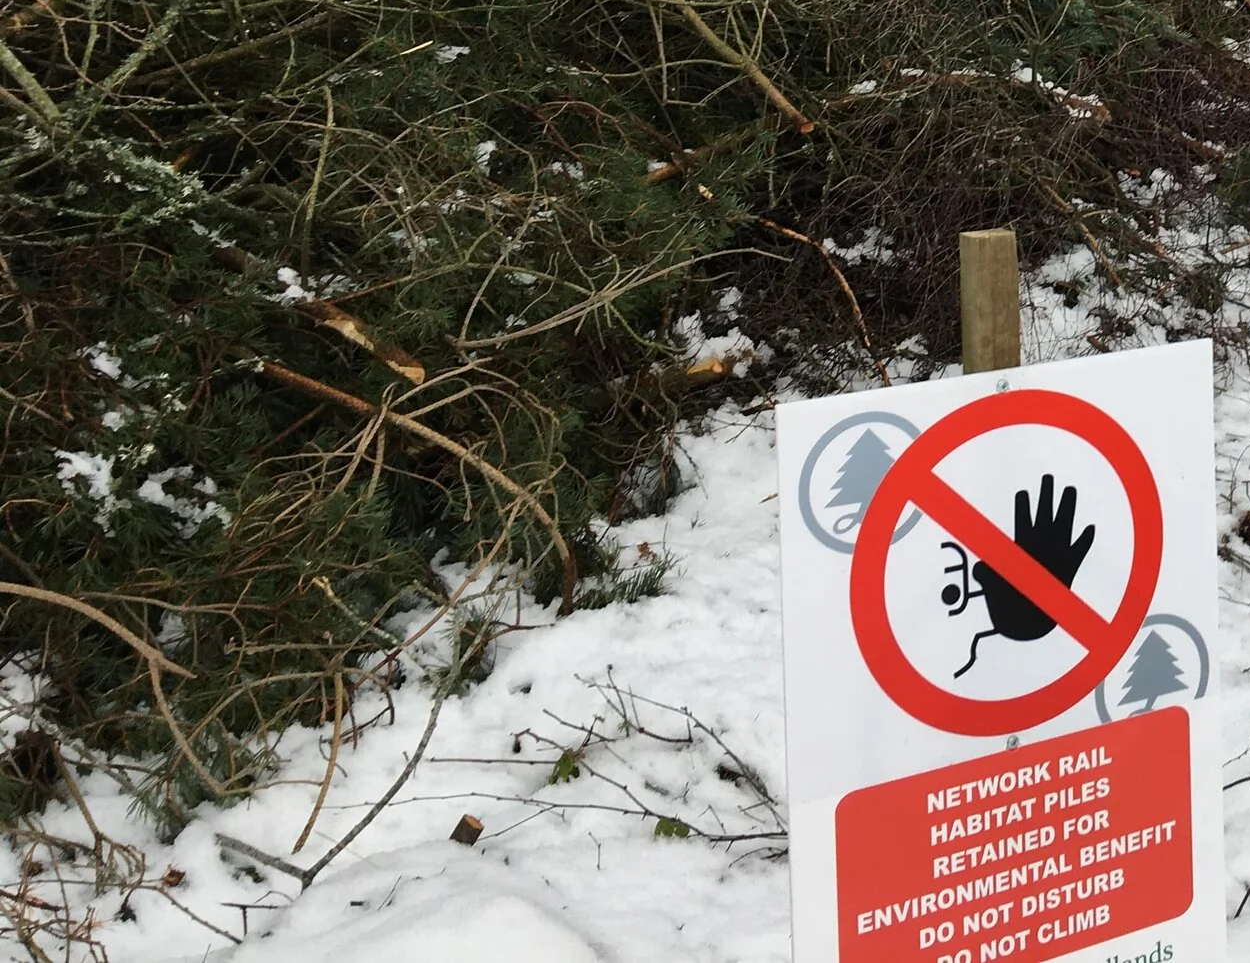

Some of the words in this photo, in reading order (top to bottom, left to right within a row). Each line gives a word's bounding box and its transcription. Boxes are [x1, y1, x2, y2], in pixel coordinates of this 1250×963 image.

[928, 761, 1051, 814] NETWORK
[1058, 746, 1113, 778] RAIL
[930, 797, 1037, 846] HABITAT
[1044, 777, 1110, 814] PILES
[857, 853, 1073, 935] ENVIRONMENTAL
[1079, 819, 1177, 868] BENEFIT
[933, 825, 1056, 879] RETAINED
[1063, 809, 1110, 841] FOR
[919, 921, 955, 950] DO
[963, 901, 1014, 936] NOT
[1021, 868, 1125, 918] DISTURB
[980, 928, 1031, 963] NOT
[1037, 904, 1111, 944] CLIMB
